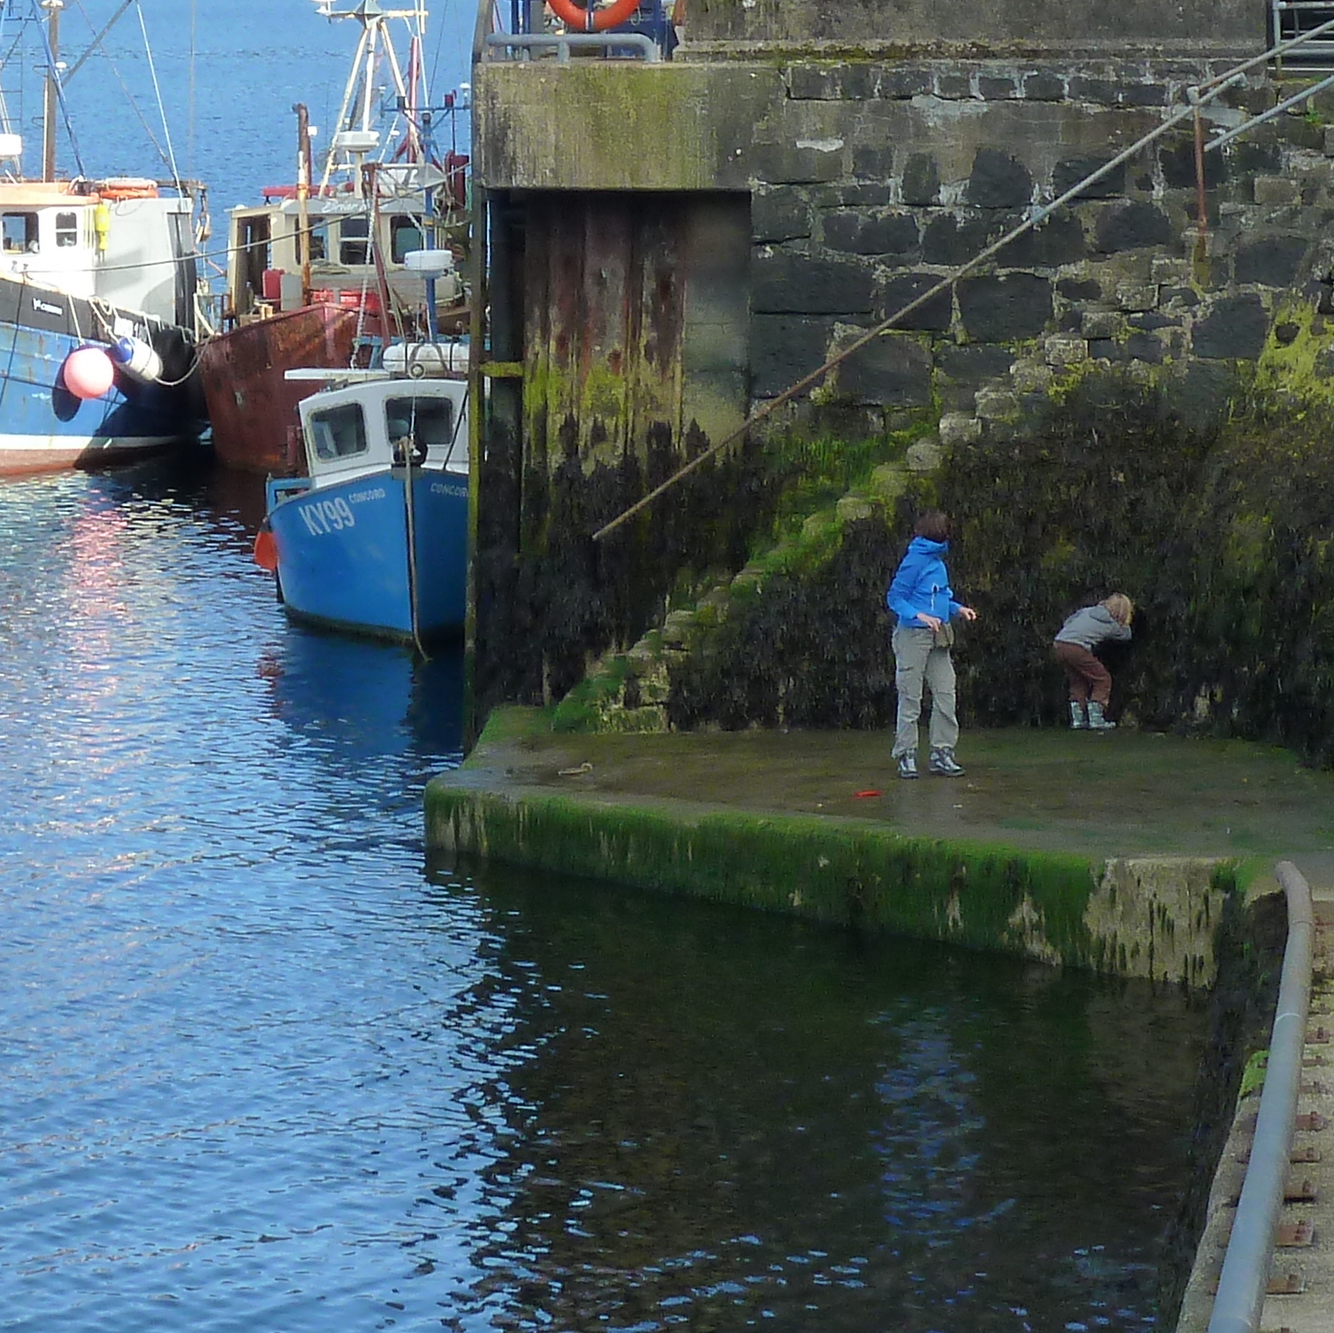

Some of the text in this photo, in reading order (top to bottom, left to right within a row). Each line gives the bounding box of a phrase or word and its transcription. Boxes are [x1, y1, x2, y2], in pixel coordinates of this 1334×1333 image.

[348, 487, 386, 504] CONCORD
[430, 482, 468, 498] CONCOR
[298, 496, 356, 536] KY99
